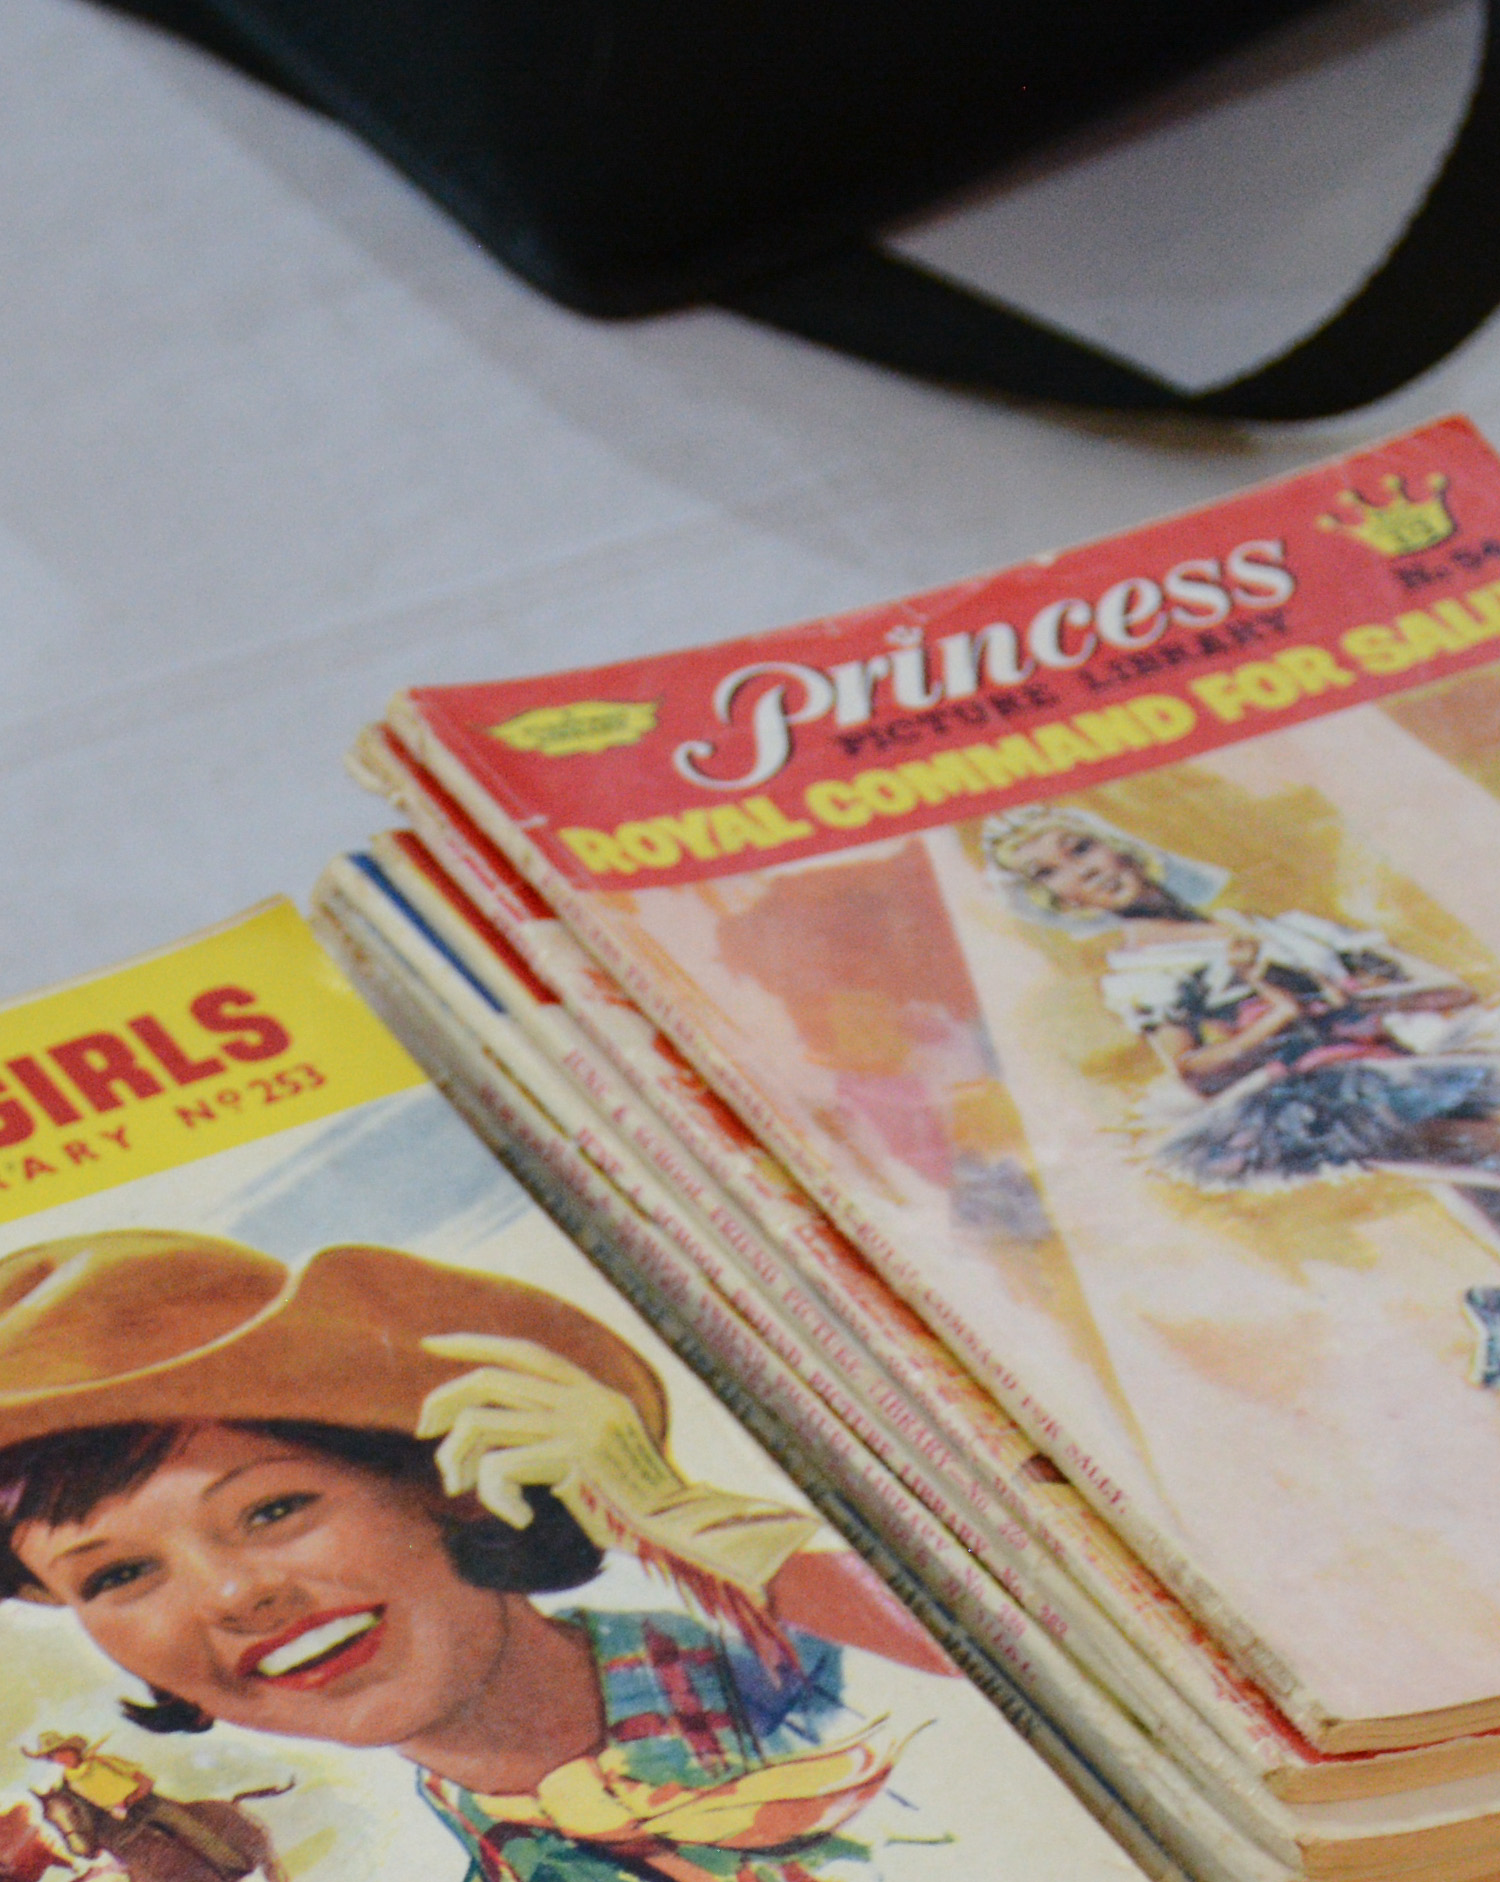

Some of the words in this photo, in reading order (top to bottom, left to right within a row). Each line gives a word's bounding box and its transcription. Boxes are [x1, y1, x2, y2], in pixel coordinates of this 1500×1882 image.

[672, 537, 1296, 790] Princess
[839, 676, 1053, 759] PICTURE
[1080, 611, 1290, 693] LIBRARY
[558, 788, 814, 880] ROYAL
[832, 693, 1197, 827] COMMAND
[1189, 643, 1338, 725] FOR
[250, 1060, 331, 1115] 253
[778, 1283, 867, 1376] PICTURE
